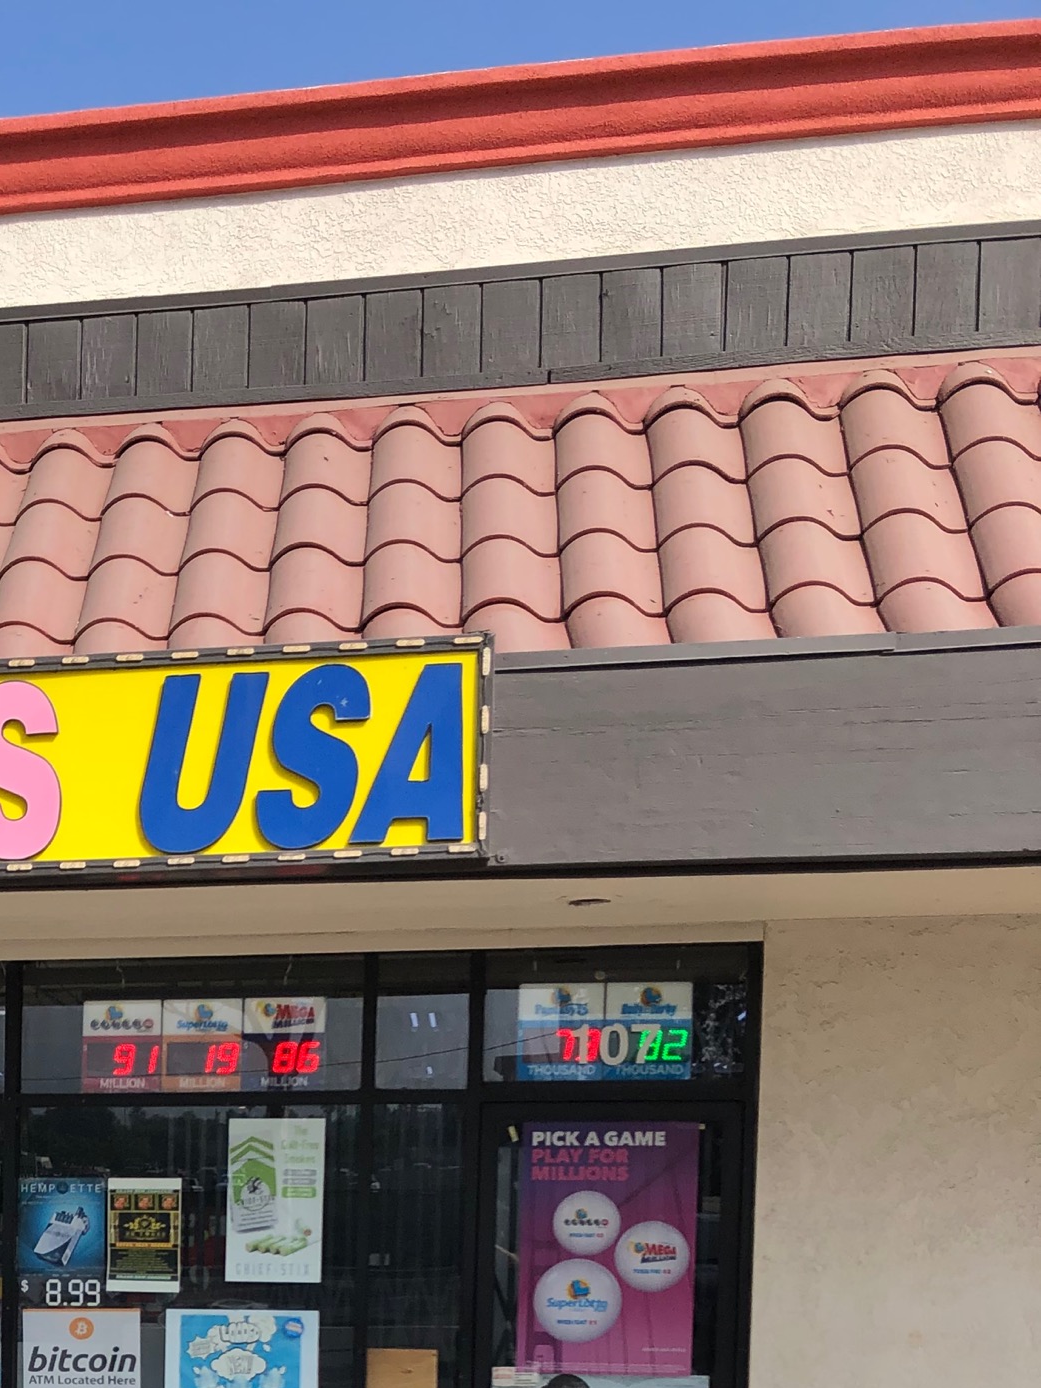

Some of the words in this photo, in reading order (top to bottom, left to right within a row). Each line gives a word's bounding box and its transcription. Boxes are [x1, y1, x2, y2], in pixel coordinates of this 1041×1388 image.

[139, 662, 464, 855] USA
[572, 1023, 662, 1067] 107
[113, 1043, 159, 1076] 91
[205, 1042, 240, 1075] 19
[272, 1041, 320, 1074] 86
[527, 1064, 596, 1075] THOUSAND
[615, 1064, 684, 1075] THOUSAND
[99, 1076, 146, 1089] MILLION
[179, 1075, 226, 1088] MILLION
[260, 1074, 308, 1088] MILLION
[532, 1131, 580, 1147] PICK
[584, 1132, 601, 1146] A
[604, 1131, 667, 1147] GAME
[532, 1149, 583, 1163] PLAY
[588, 1149, 628, 1163] FOR
[531, 1166, 629, 1181] MILLIONS
[21, 1183, 56, 1194] HEMP
[70, 1183, 102, 1194] ETTE
[21, 1280, 29, 1293] $
[46, 1279, 101, 1307] 8.99
[27, 1346, 137, 1373] bitcoin
[28, 1375, 55, 1385] ATM
[58, 1375, 105, 1386] Located
[107, 1375, 136, 1386] Here
